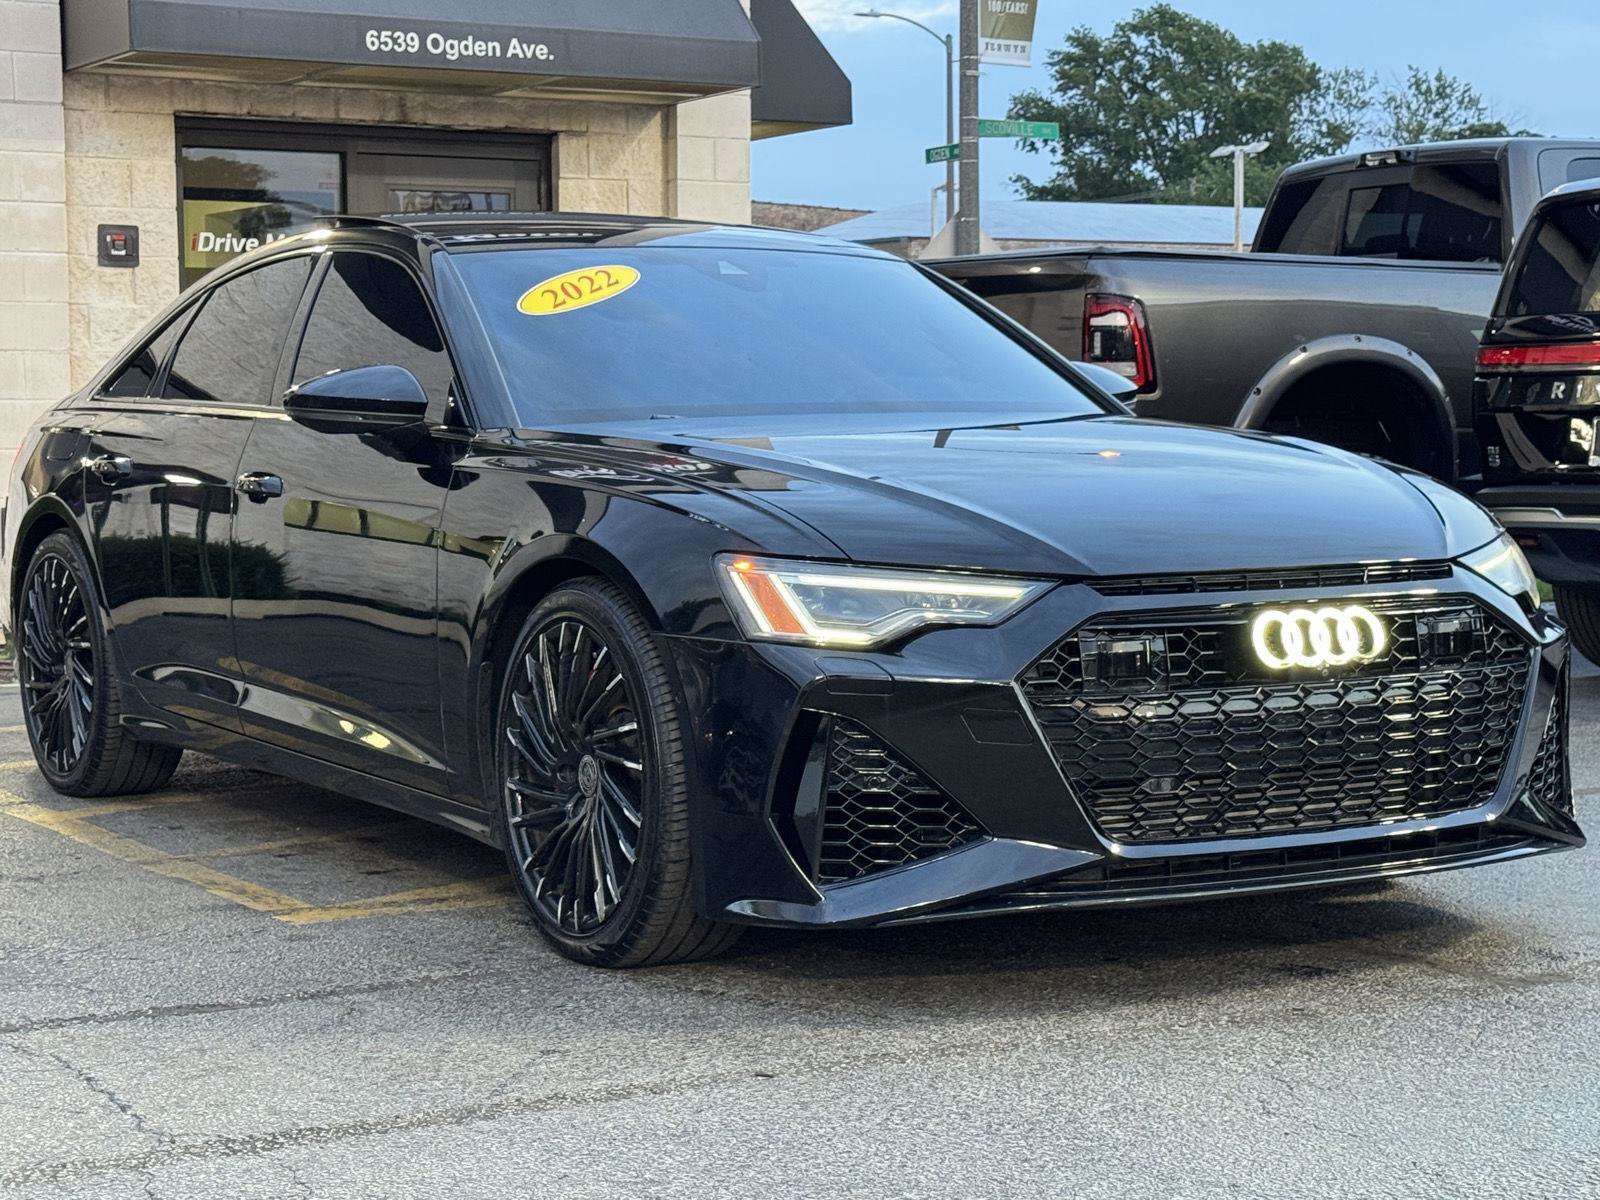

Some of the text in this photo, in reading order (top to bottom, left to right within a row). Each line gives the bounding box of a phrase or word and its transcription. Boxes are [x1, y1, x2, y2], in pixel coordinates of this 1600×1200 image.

[365, 30, 555, 60] 6539 Ogden Ave.
[985, 121, 1035, 136] SCOVILLE
[929, 147, 950, 162] OGDEN
[191, 231, 260, 253] iDrive
[541, 270, 619, 309] 2022
